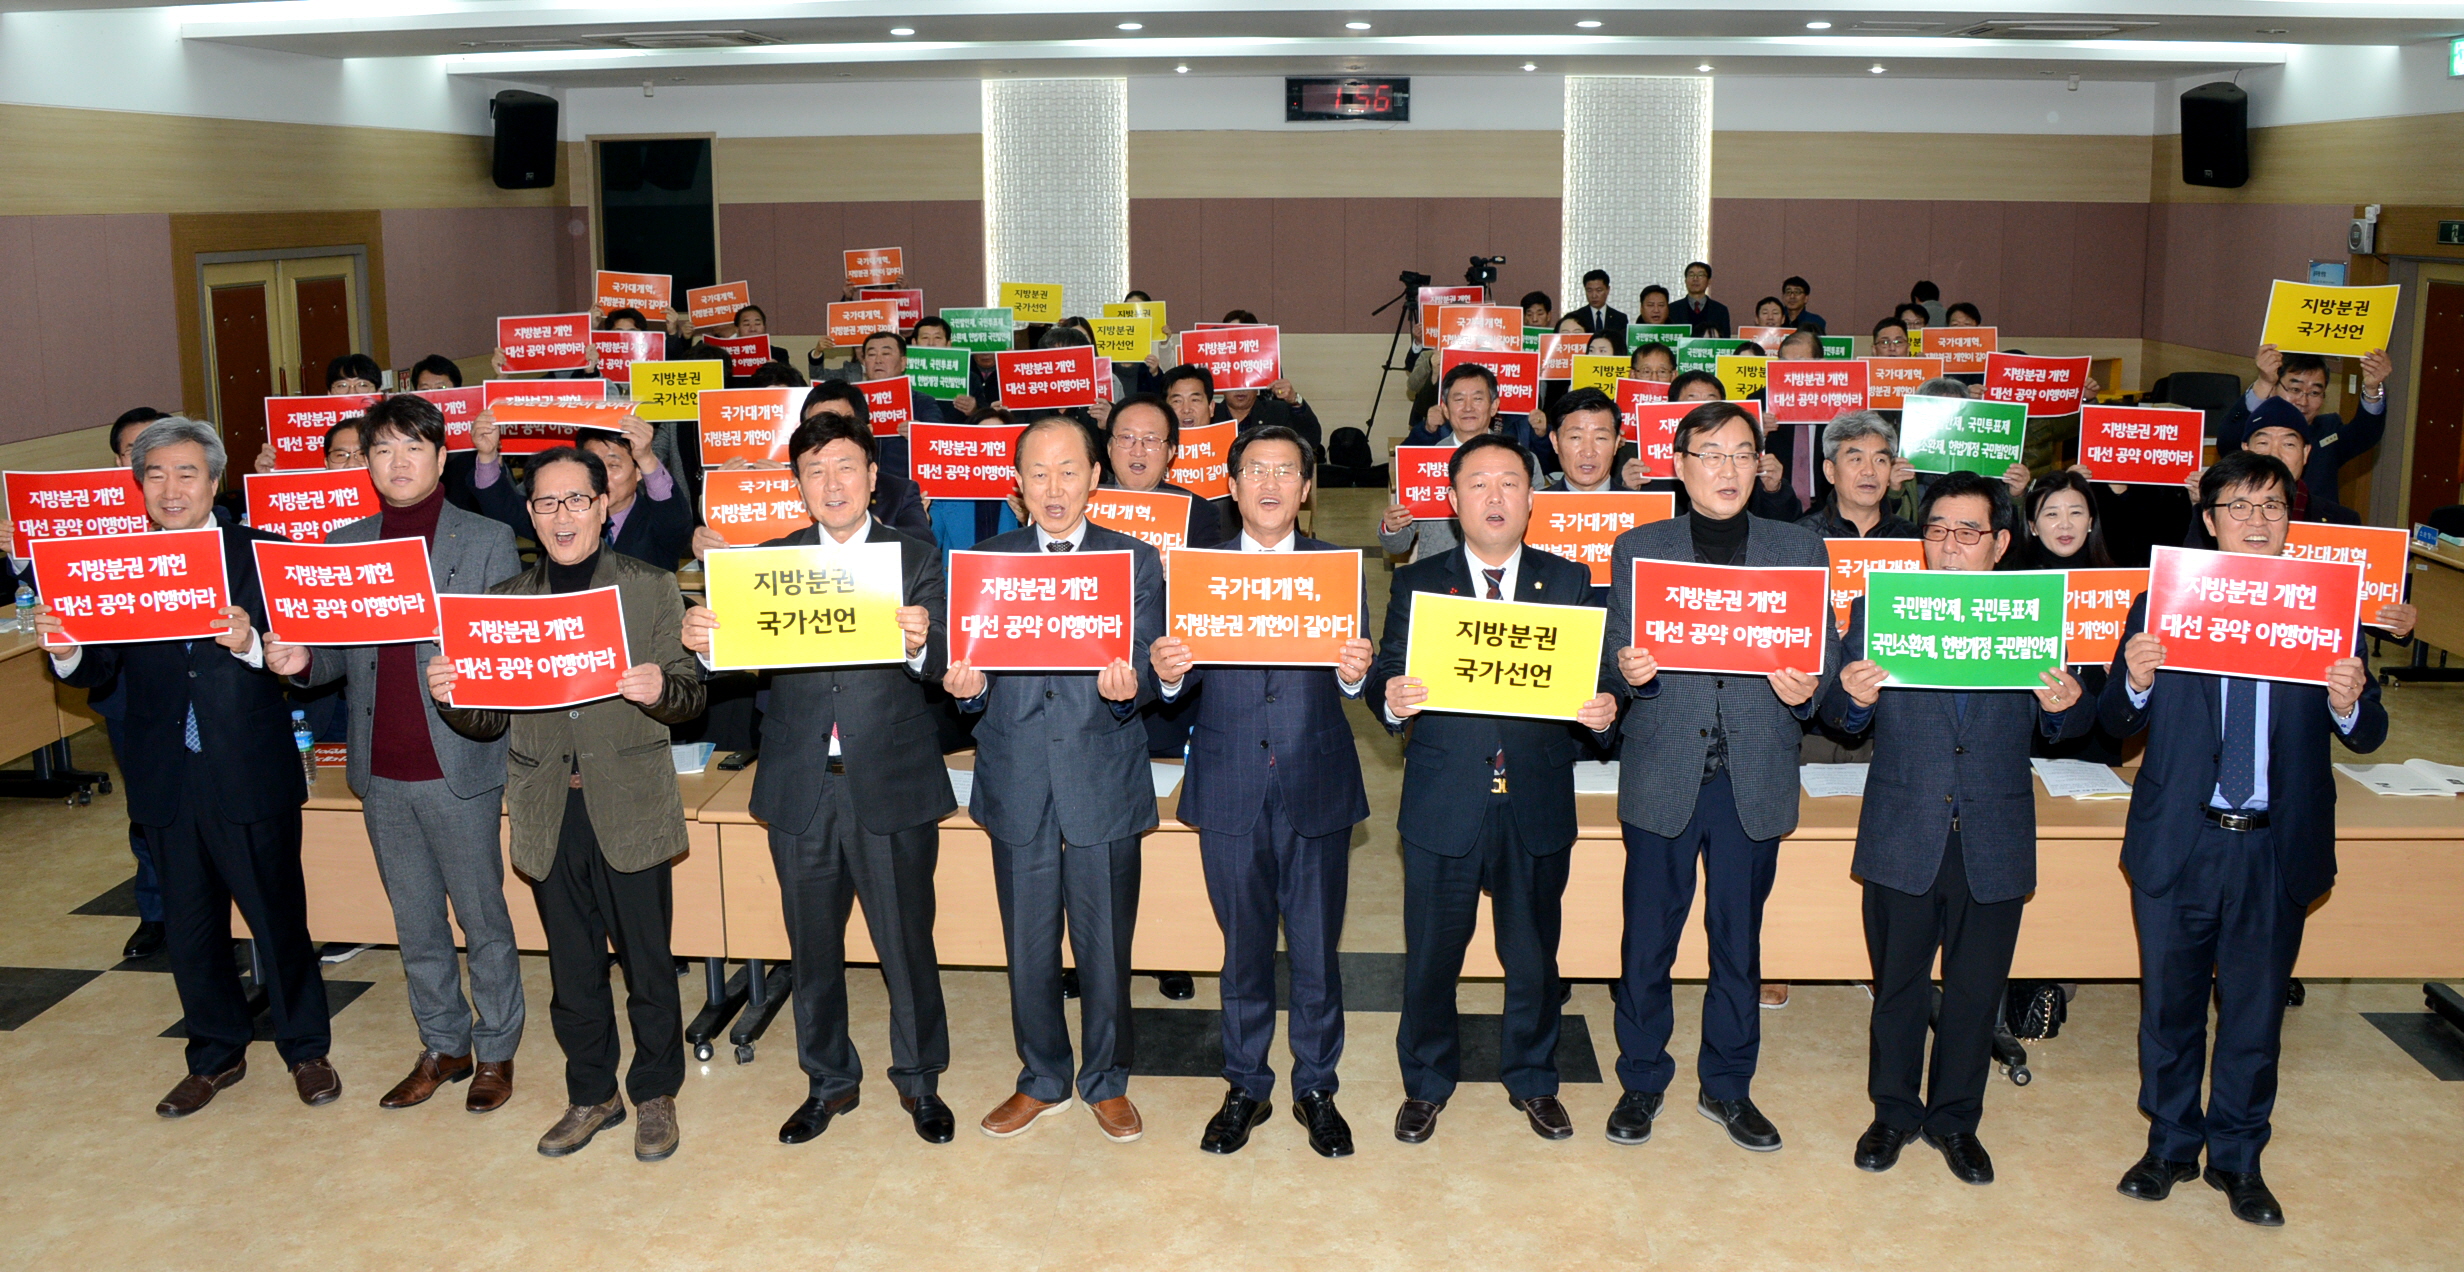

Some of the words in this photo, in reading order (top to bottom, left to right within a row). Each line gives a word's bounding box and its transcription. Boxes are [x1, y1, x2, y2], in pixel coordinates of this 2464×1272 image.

[1014, 289, 1048, 300] 지방분권
[1014, 302, 1047, 313] 국가선언
[2300, 297, 2370, 318] 지방분권
[514, 326, 552, 339] 지방분권
[553, 324, 573, 338] 개헌
[1097, 325, 1135, 336] 지방분권
[2297, 320, 2365, 341] 국가선언
[505, 345, 525, 358] 대선
[526, 344, 545, 357] 공약
[547, 342, 585, 356] 이행하라
[1097, 340, 1134, 351] 국가선언
[1197, 341, 1237, 356] 지방분권
[1238, 339, 1260, 353] 개헌
[1013, 361, 1054, 375] 지방분권
[1055, 359, 1076, 373] 개헌
[1211, 361, 1232, 375] 공약
[1233, 359, 1274, 373] 이행하라
[1500, 363, 1521, 378] 개헌
[1736, 365, 1766, 378] 지방분
[1875, 368, 1926, 381] 국가대개혁,
[2002, 368, 2047, 383] 지방분권
[2048, 369, 2070, 383] 개헌
[652, 371, 701, 386] 지방분권
[1006, 382, 1027, 395] 대선
[1027, 381, 1049, 394] 공약
[1050, 378, 1090, 393] 이행하라
[1783, 372, 1825, 387] 지방분권
[1827, 371, 1849, 386] 개헌
[870, 390, 893, 405] 개헌
[1773, 393, 1795, 407] 대선
[1797, 393, 1819, 407] 공약
[1820, 392, 1863, 407] 이행하라
[1869, 386, 1891, 397] 방분권
[1892, 385, 1915, 397] 개헌이
[1990, 387, 2013, 401] 대선
[2015, 388, 2038, 402] 공약
[2038, 388, 2080, 402] 이행하라
[444, 400, 467, 416] 개헌
[287, 411, 337, 428] 지방분권
[1968, 417, 2011, 436] 국민투표제
[704, 430, 742, 447] 지방분권
[743, 430, 776, 447] 개헌이
[2101, 421, 2151, 440] 지방분권
[2153, 424, 2179, 441] 개헌
[277, 436, 303, 452] 대선
[929, 440, 978, 456] 지방분권
[980, 440, 1006, 457] 개헌
[1647, 443, 1673, 460] 대선
[1948, 440, 1980, 457] 헌법개정
[1981, 443, 2020, 461] 국민발안제
[2087, 446, 2113, 463] 대선
[2115, 447, 2142, 464] 공약
[2143, 448, 2194, 467] 이행하라
[917, 463, 942, 479] 대선
[944, 464, 970, 480] 공약
[1172, 468, 1204, 484] 개헌이
[29, 489, 90, 509] 지방분권
[92, 486, 125, 506] 개헌
[268, 490, 326, 511] 지방분권
[328, 487, 360, 507] 개헌
[1405, 486, 1432, 502] 대선
[711, 502, 767, 524] 지방분권
[1084, 503, 1156, 522] 가대개혁,
[19, 519, 50, 537] 대선
[52, 517, 83, 536] 공약
[86, 515, 150, 535] 이행하라
[289, 519, 319, 541] 공약
[67, 555, 144, 582] 지방분권
[148, 553, 188, 577] 개헌
[284, 564, 354, 587] 지방분권
[355, 562, 395, 585] 개헌
[753, 568, 855, 597] 지방분권
[980, 576, 1056, 601] 지방분권
[1060, 576, 1098, 601] 개헌
[1207, 576, 1321, 602] 국가대개혁,
[53, 594, 94, 617] 대선
[96, 592, 136, 616] 공약
[139, 587, 217, 613] 이행하라
[1665, 586, 1743, 612] 지방분권
[1746, 590, 1787, 614] 개헌
[2184, 575, 2269, 607] 지방분권
[2273, 583, 2317, 610] 개헌
[274, 598, 311, 619] 대선
[312, 598, 348, 620] 공약
[351, 593, 426, 618] 이행하라
[1891, 596, 1966, 623] 국민발안제,
[1970, 598, 2040, 622] 국민투표제
[468, 619, 541, 644] 지방분권
[543, 616, 585, 641] 개헌
[756, 607, 857, 637] 국가선언
[961, 614, 999, 639] 대선
[1003, 615, 1044, 639] 공약
[1047, 614, 1123, 640] 이행하라
[1174, 613, 1244, 638] 지방분권
[1247, 614, 1299, 638] 개헌이
[1303, 614, 1355, 639] 길이다
[2078, 620, 2119, 640] 개헌이
[1456, 620, 1558, 651] 지방분권
[1645, 620, 1684, 644] 대선
[1688, 622, 1729, 646] 공약
[1732, 626, 1813, 649] 이행하라
[2160, 613, 2202, 640] 대선
[2207, 617, 2252, 644] 공약
[2255, 623, 2343, 653] 이행하라
[1871, 632, 1939, 660] 국민소환제,
[1941, 635, 1992, 661] 헌법개정
[1994, 636, 2058, 660] 국민발안제
[454, 657, 493, 680] 대선
[495, 656, 534, 681] 공약
[537, 647, 617, 678] 이행하라
[1453, 658, 1552, 689] 국가선언
